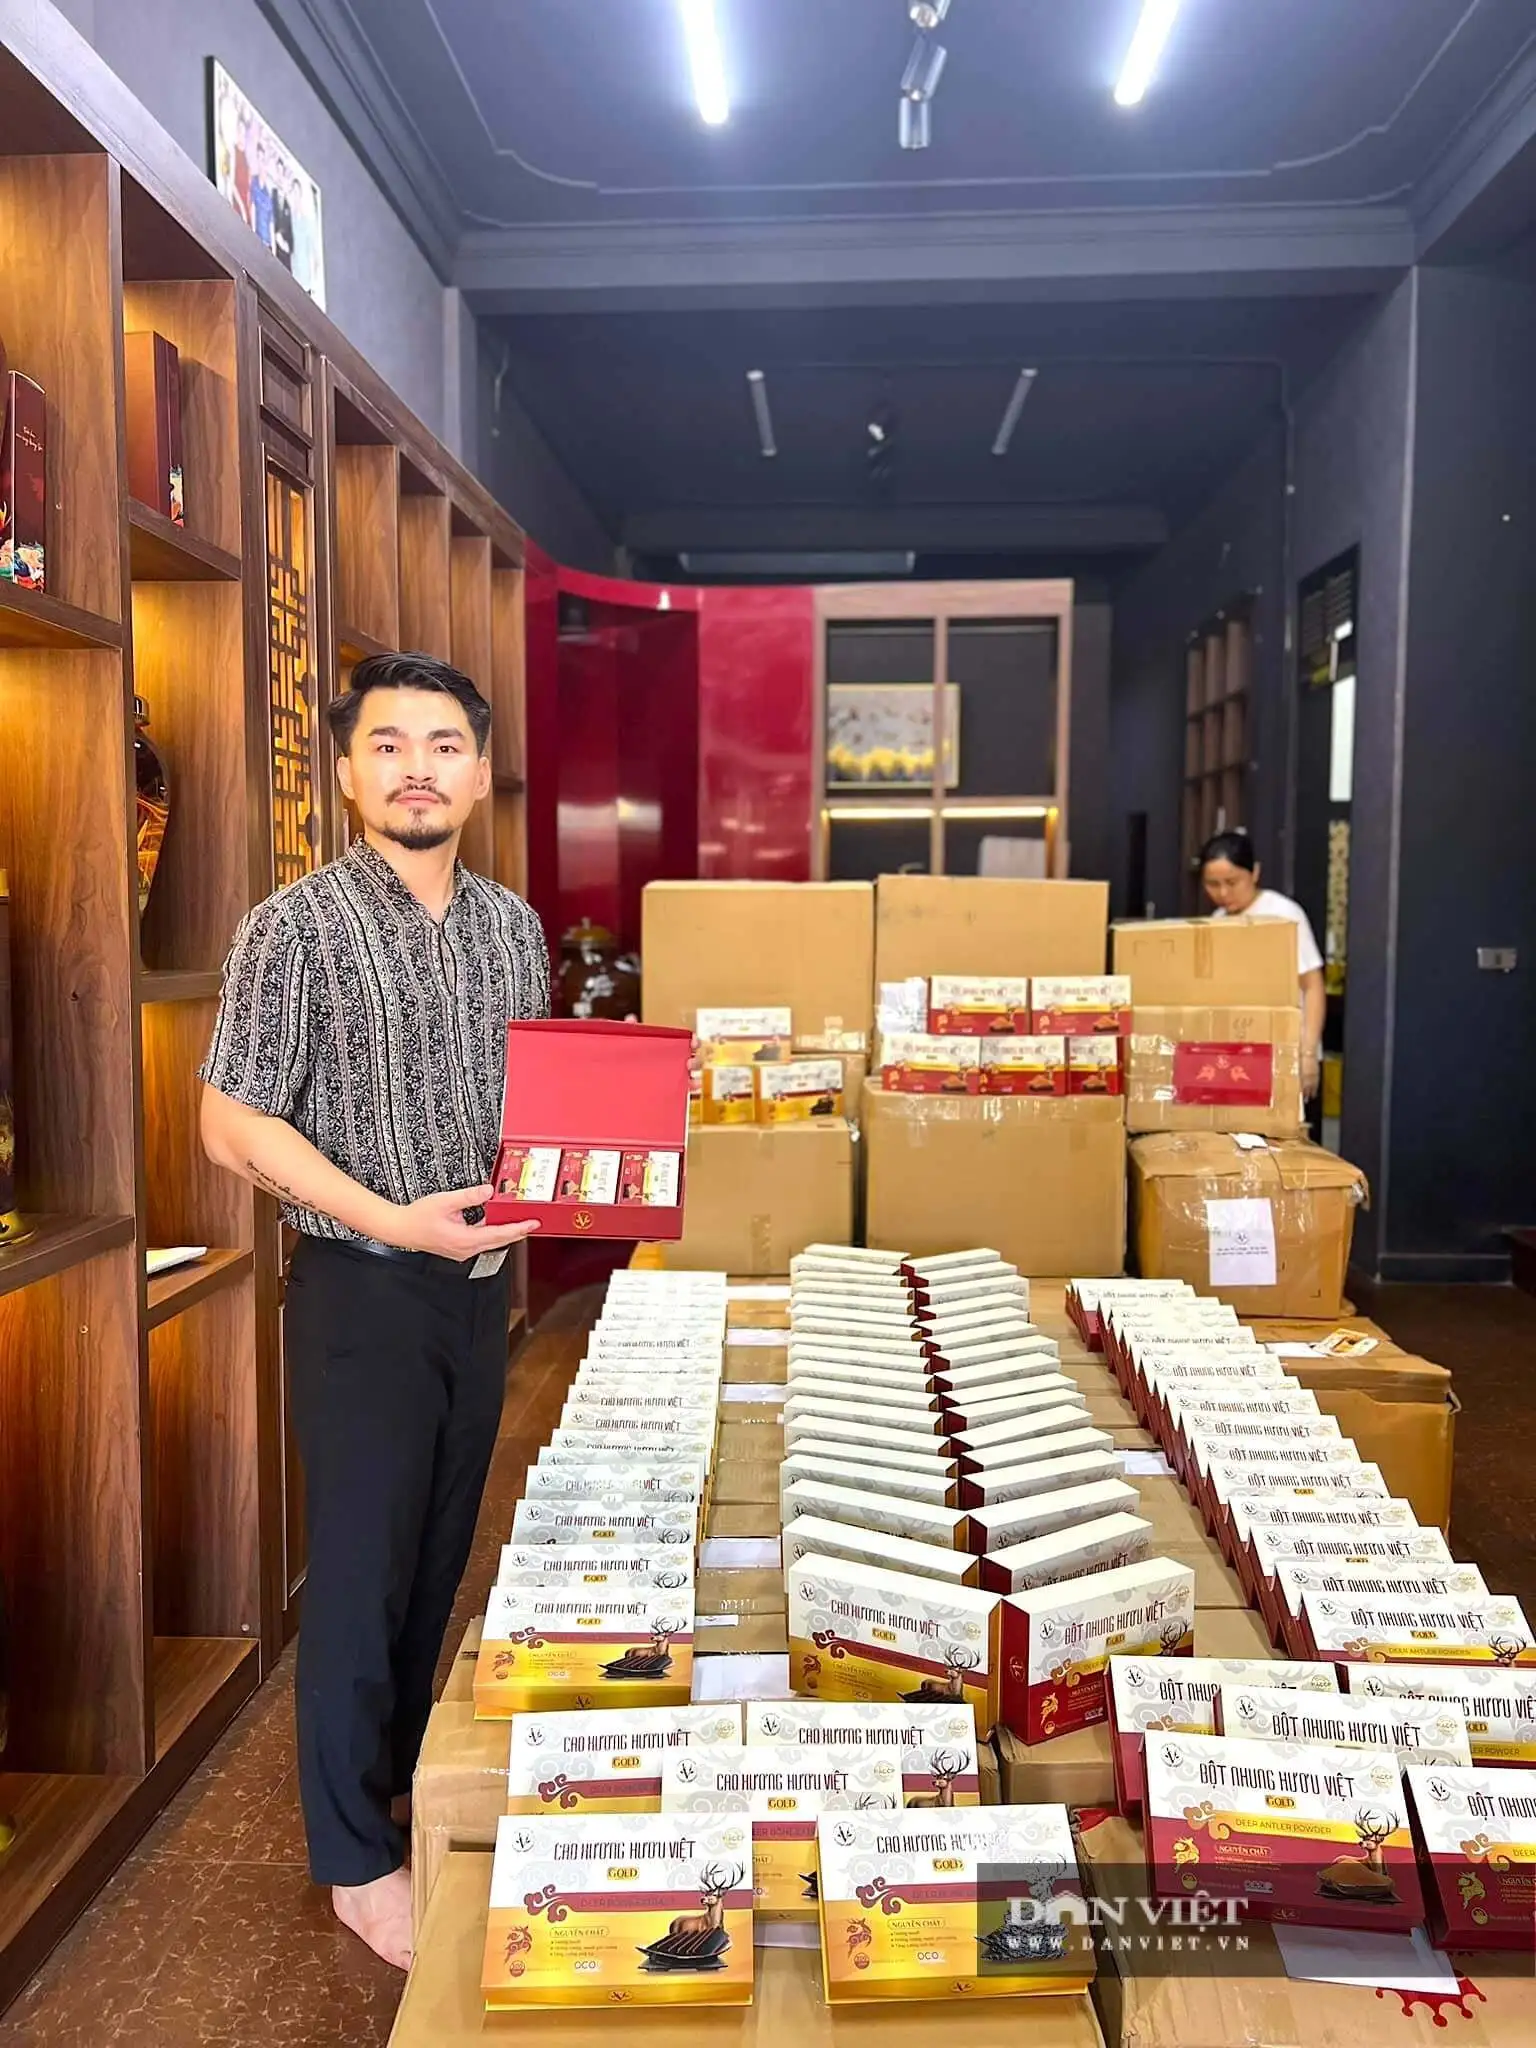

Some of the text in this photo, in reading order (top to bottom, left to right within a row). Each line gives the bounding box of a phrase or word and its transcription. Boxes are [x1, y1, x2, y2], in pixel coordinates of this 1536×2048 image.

[1330, 1474, 1352, 1489] VIỆT
[637, 1515, 657, 1529] VIỆT
[1358, 1510, 1381, 1526] VIỆT
[1386, 1540, 1411, 1558] VIỆT
[631, 1559, 651, 1572] VIỆT
[1424, 1577, 1448, 1594] VIỆT
[627, 1601, 648, 1616] VIỆT
[831, 1600, 850, 1616] CAO
[918, 1619, 941, 1640] VIỆT
[1065, 1600, 1165, 1646] BỘT NHUNG HƯƠU VIỆT
[1351, 1608, 1484, 1631] BỘT NHUNG HƯƠU VIỆT
[1159, 1678, 1184, 1704] BỘT
[1474, 1698, 1511, 1718] HƯƠU
[563, 1735, 584, 1753] CAO
[666, 1728, 691, 1747] VIỆT
[799, 1727, 820, 1745] CAO
[900, 1725, 925, 1748] VIỆT
[1272, 1712, 1421, 1751] BỘT NHUNG HƯƠU VIỆT
[612, 1756, 640, 1767] GOLD
[717, 1774, 738, 1791] CAO
[823, 1769, 849, 1794] VIỆT
[1199, 1760, 1355, 1801] BỘT NHUNG HƯƠU VIỆT
[768, 1799, 796, 1809] GOLD
[1266, 1795, 1295, 1808] GOLD
[1467, 1792, 1536, 1821] BỘT NHUN
[1236, 1817, 1332, 1835] DEER ANTLER POWDER
[554, 1842, 578, 1861] CAO
[670, 1837, 697, 1862] VIỆT
[877, 1836, 899, 1854] CAO
[904, 1834, 947, 1852] HƯƠNG
[608, 1868, 638, 1880] GOLD
